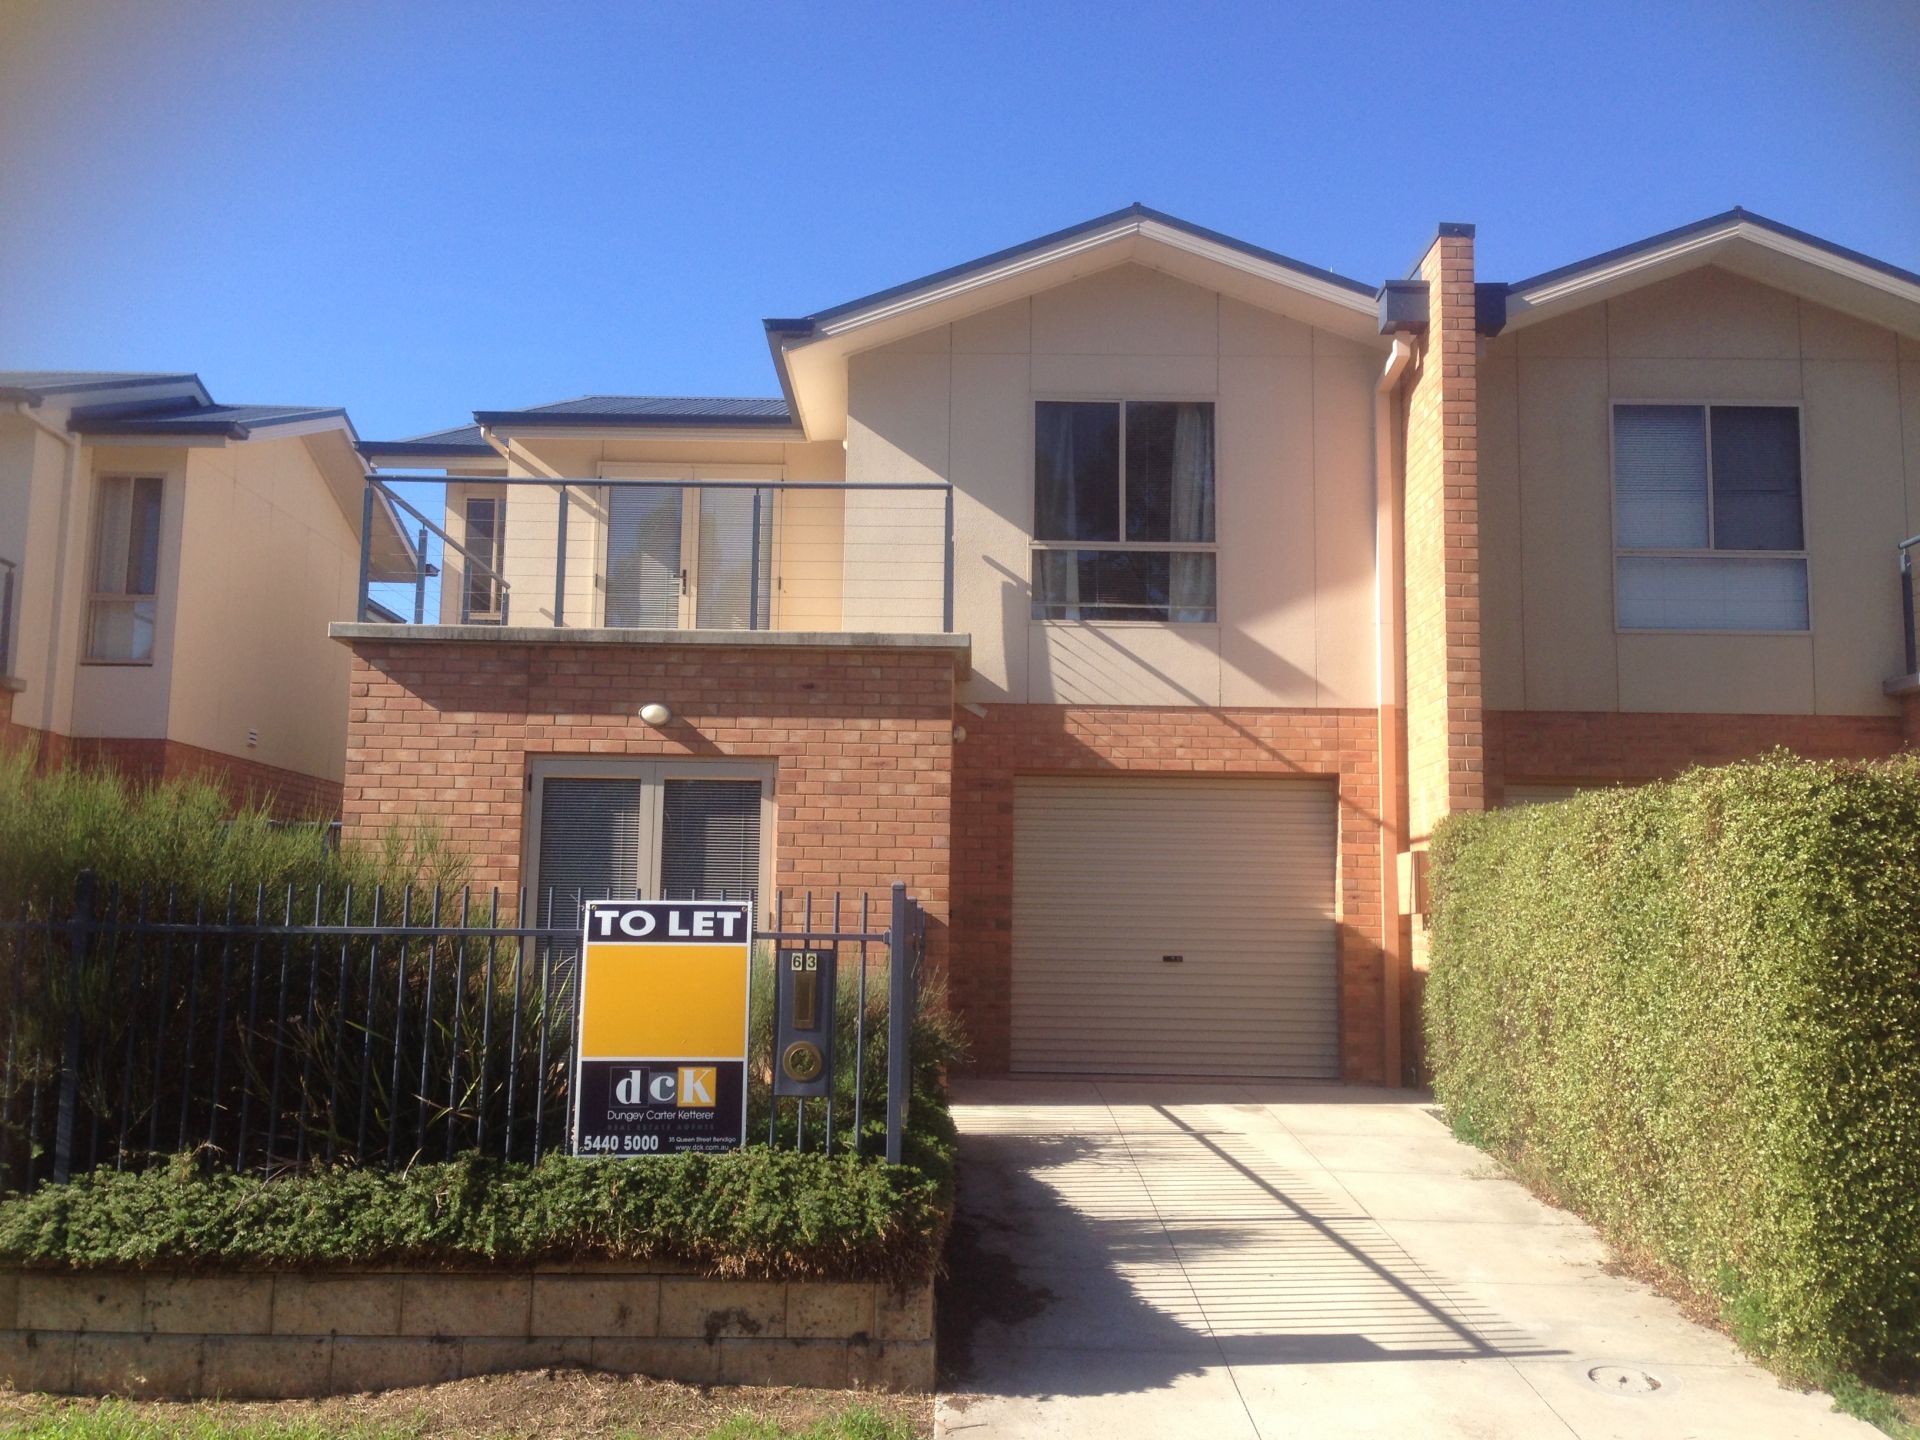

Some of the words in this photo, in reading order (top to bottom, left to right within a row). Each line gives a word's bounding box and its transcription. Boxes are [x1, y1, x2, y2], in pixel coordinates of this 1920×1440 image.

[594, 910, 656, 937] TO
[668, 911, 741, 937] LET
[793, 955, 816, 969] 63
[607, 1110, 644, 1122] Dungey
[646, 1110, 676, 1120] Carter
[678, 1110, 715, 1120] Ketterer
[584, 1135, 619, 1151] 5440
[623, 1135, 659, 1151] 5000
[713, 1136, 737, 1144] Bendigo
